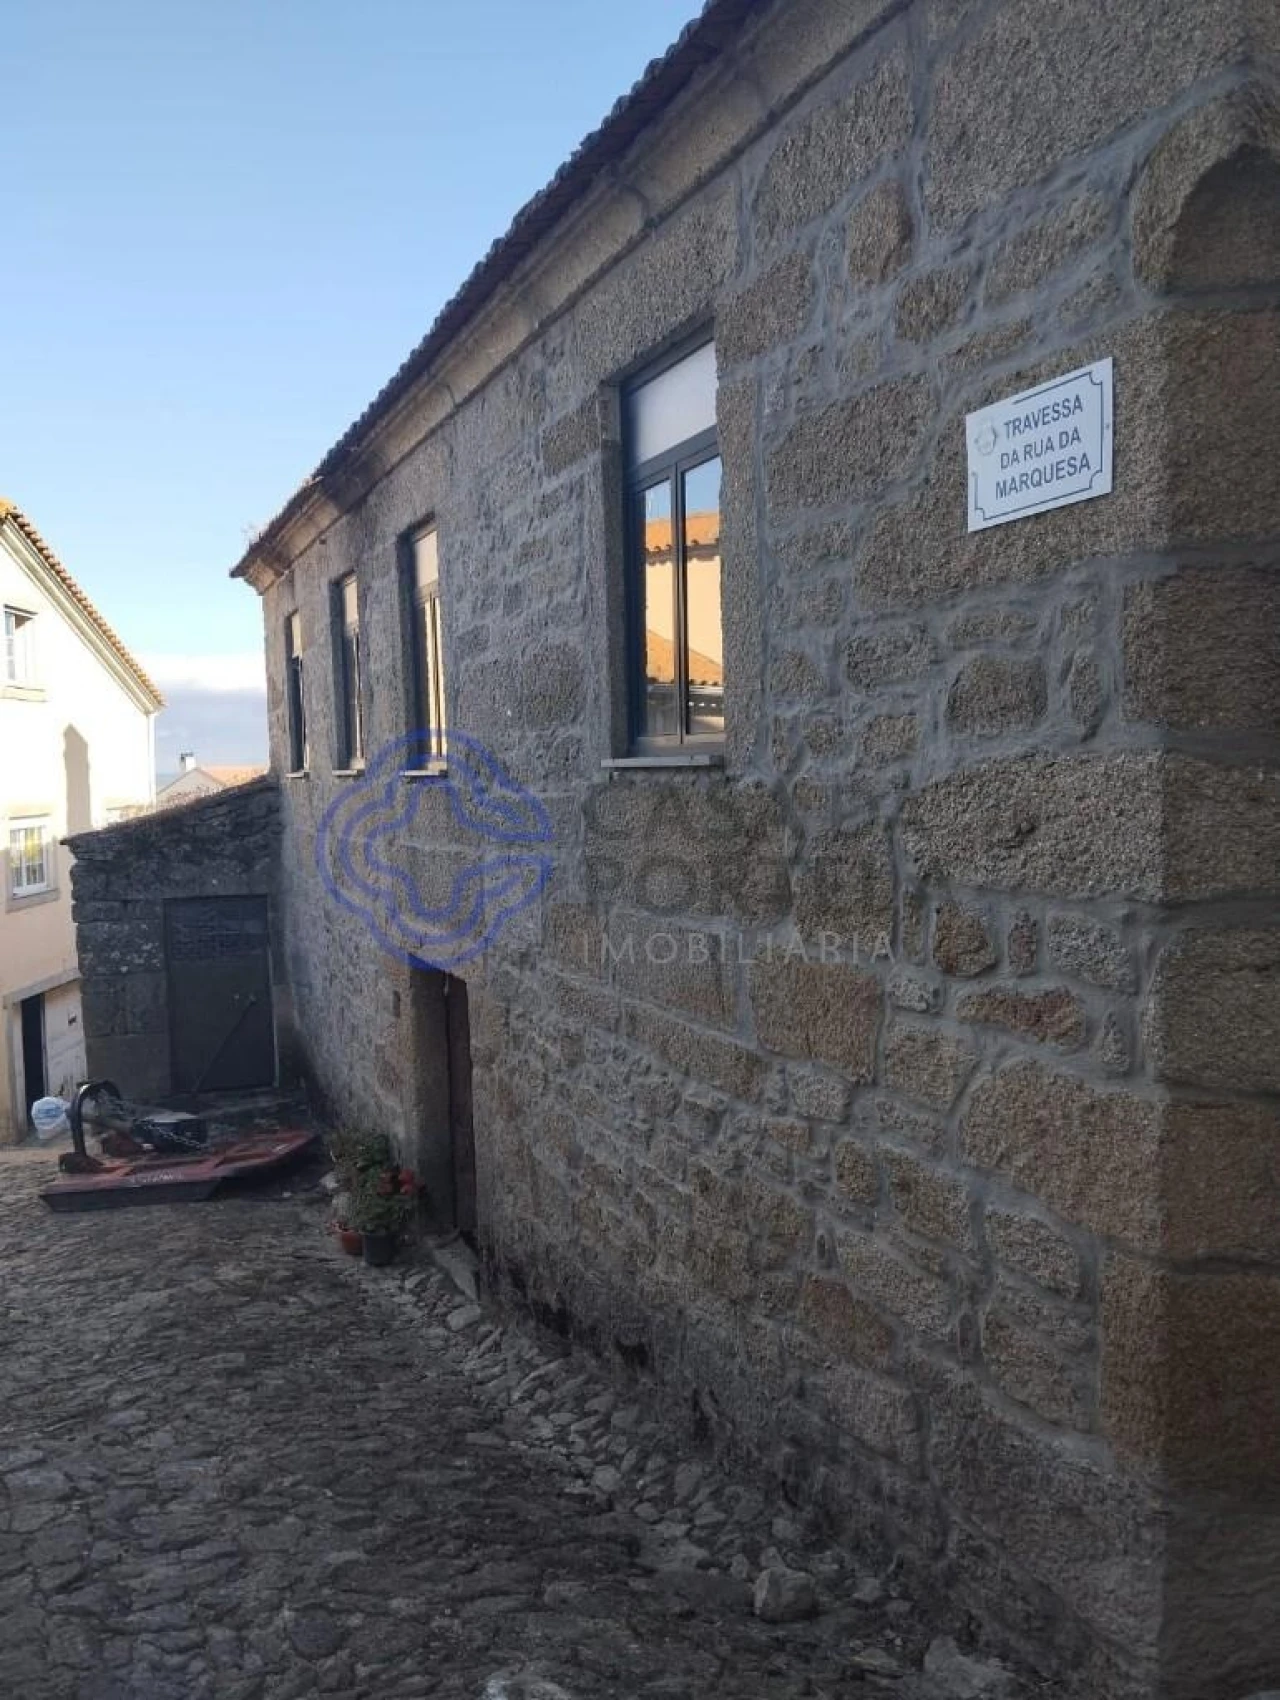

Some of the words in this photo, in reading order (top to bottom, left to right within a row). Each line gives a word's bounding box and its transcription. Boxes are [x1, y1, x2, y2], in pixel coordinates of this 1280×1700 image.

[1003, 394, 1083, 439] TRAVESSA
[1000, 452, 1020, 469] DA
[1023, 436, 1055, 461] RUA
[1059, 427, 1081, 448] DA
[995, 452, 1091, 500] MARQUESA
